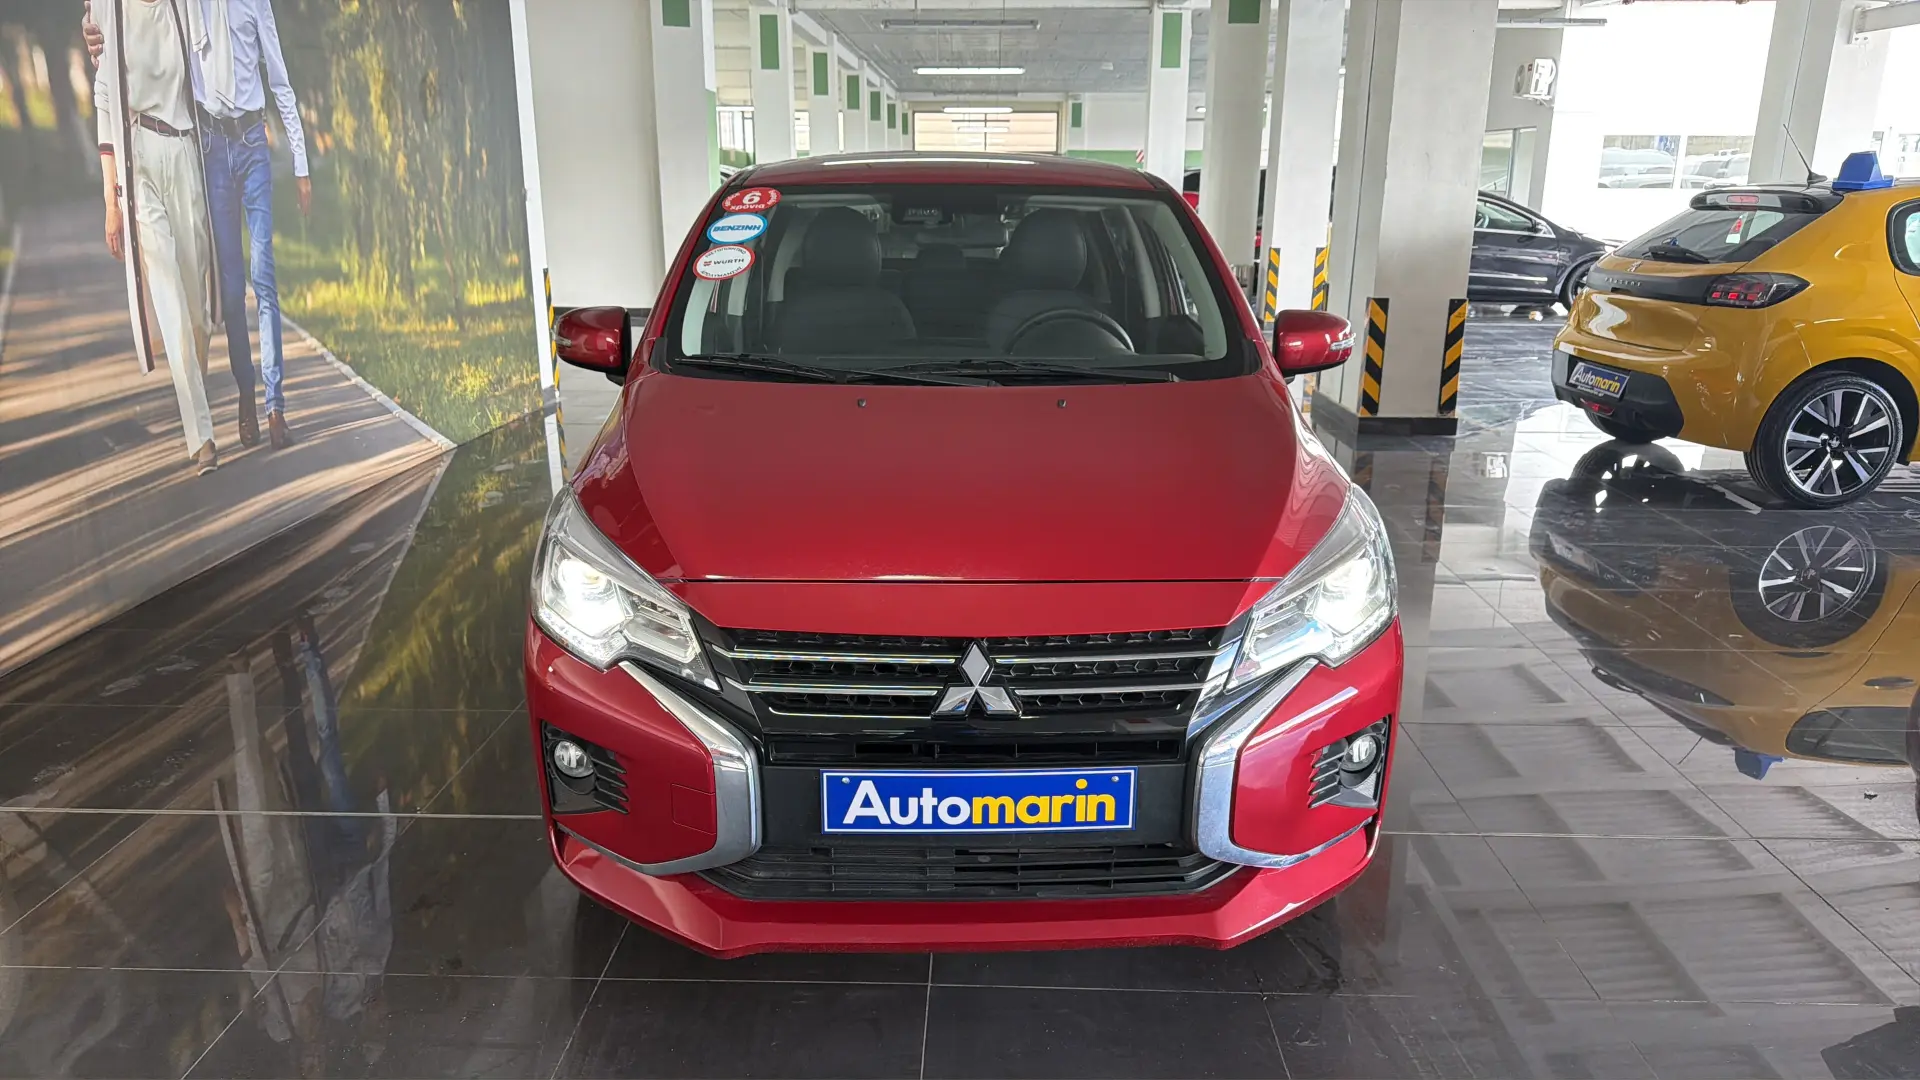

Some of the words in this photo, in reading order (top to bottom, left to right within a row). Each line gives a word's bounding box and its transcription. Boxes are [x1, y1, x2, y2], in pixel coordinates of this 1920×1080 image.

[742, 192, 762, 205] 6
[1573, 366, 1621, 394] Automarin
[842, 778, 1115, 826] Automarin
